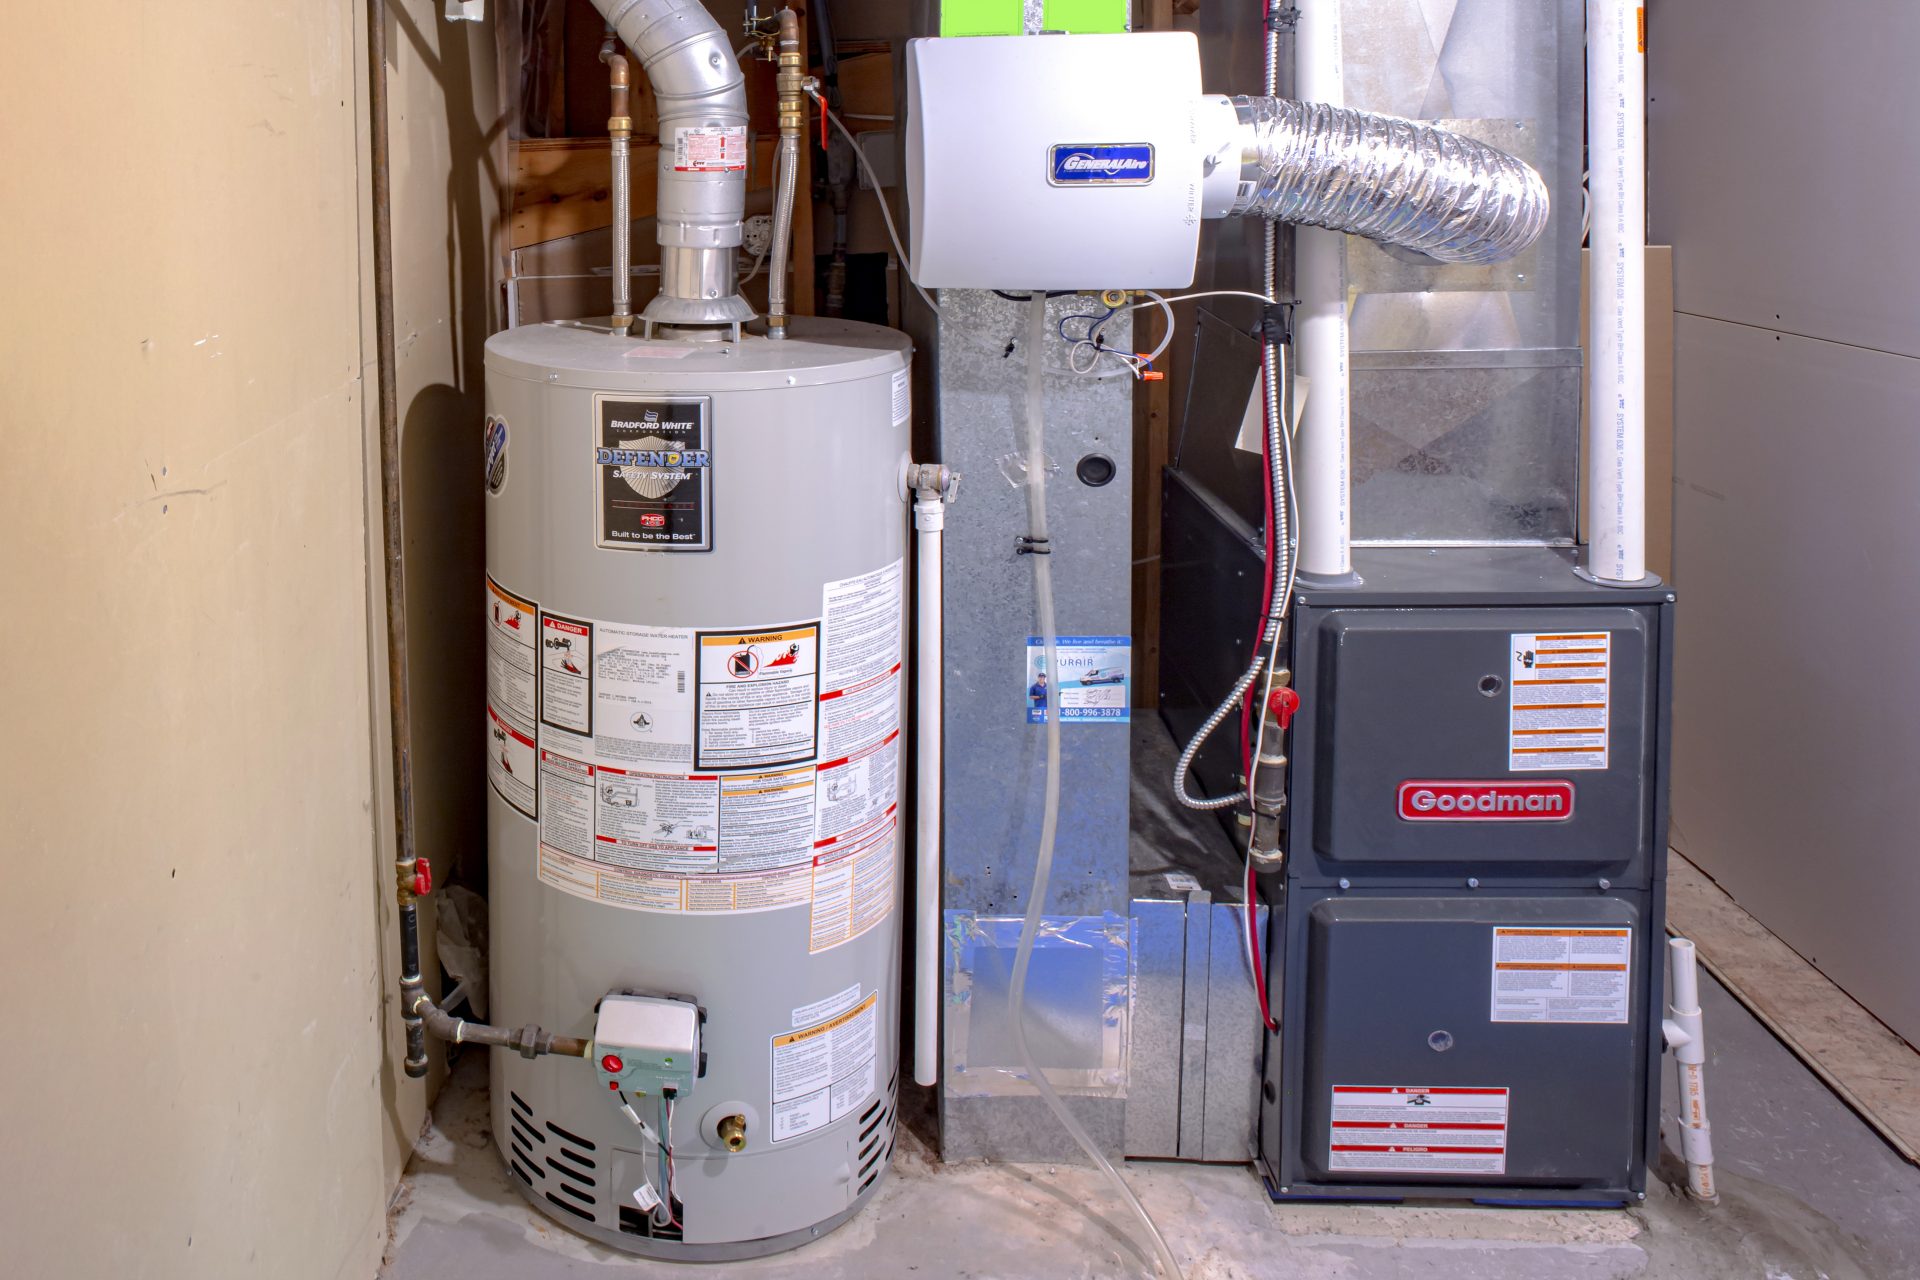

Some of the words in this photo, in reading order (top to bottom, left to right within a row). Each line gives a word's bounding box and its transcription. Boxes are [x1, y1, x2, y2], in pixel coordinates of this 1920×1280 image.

[611, 420, 660, 429] BRADFORD
[662, 421, 694, 430] WHITE
[597, 448, 711, 467] DEFENDER
[612, 471, 648, 479] SAFETY
[650, 472, 692, 480] SYSTEM
[556, 622, 582, 634] DANGER
[748, 634, 782, 643] WARNING
[1412, 790, 1562, 812] Goodman
[798, 1026, 825, 1039] WARNING
[829, 1004, 866, 1029] AVERTISSEMENT
